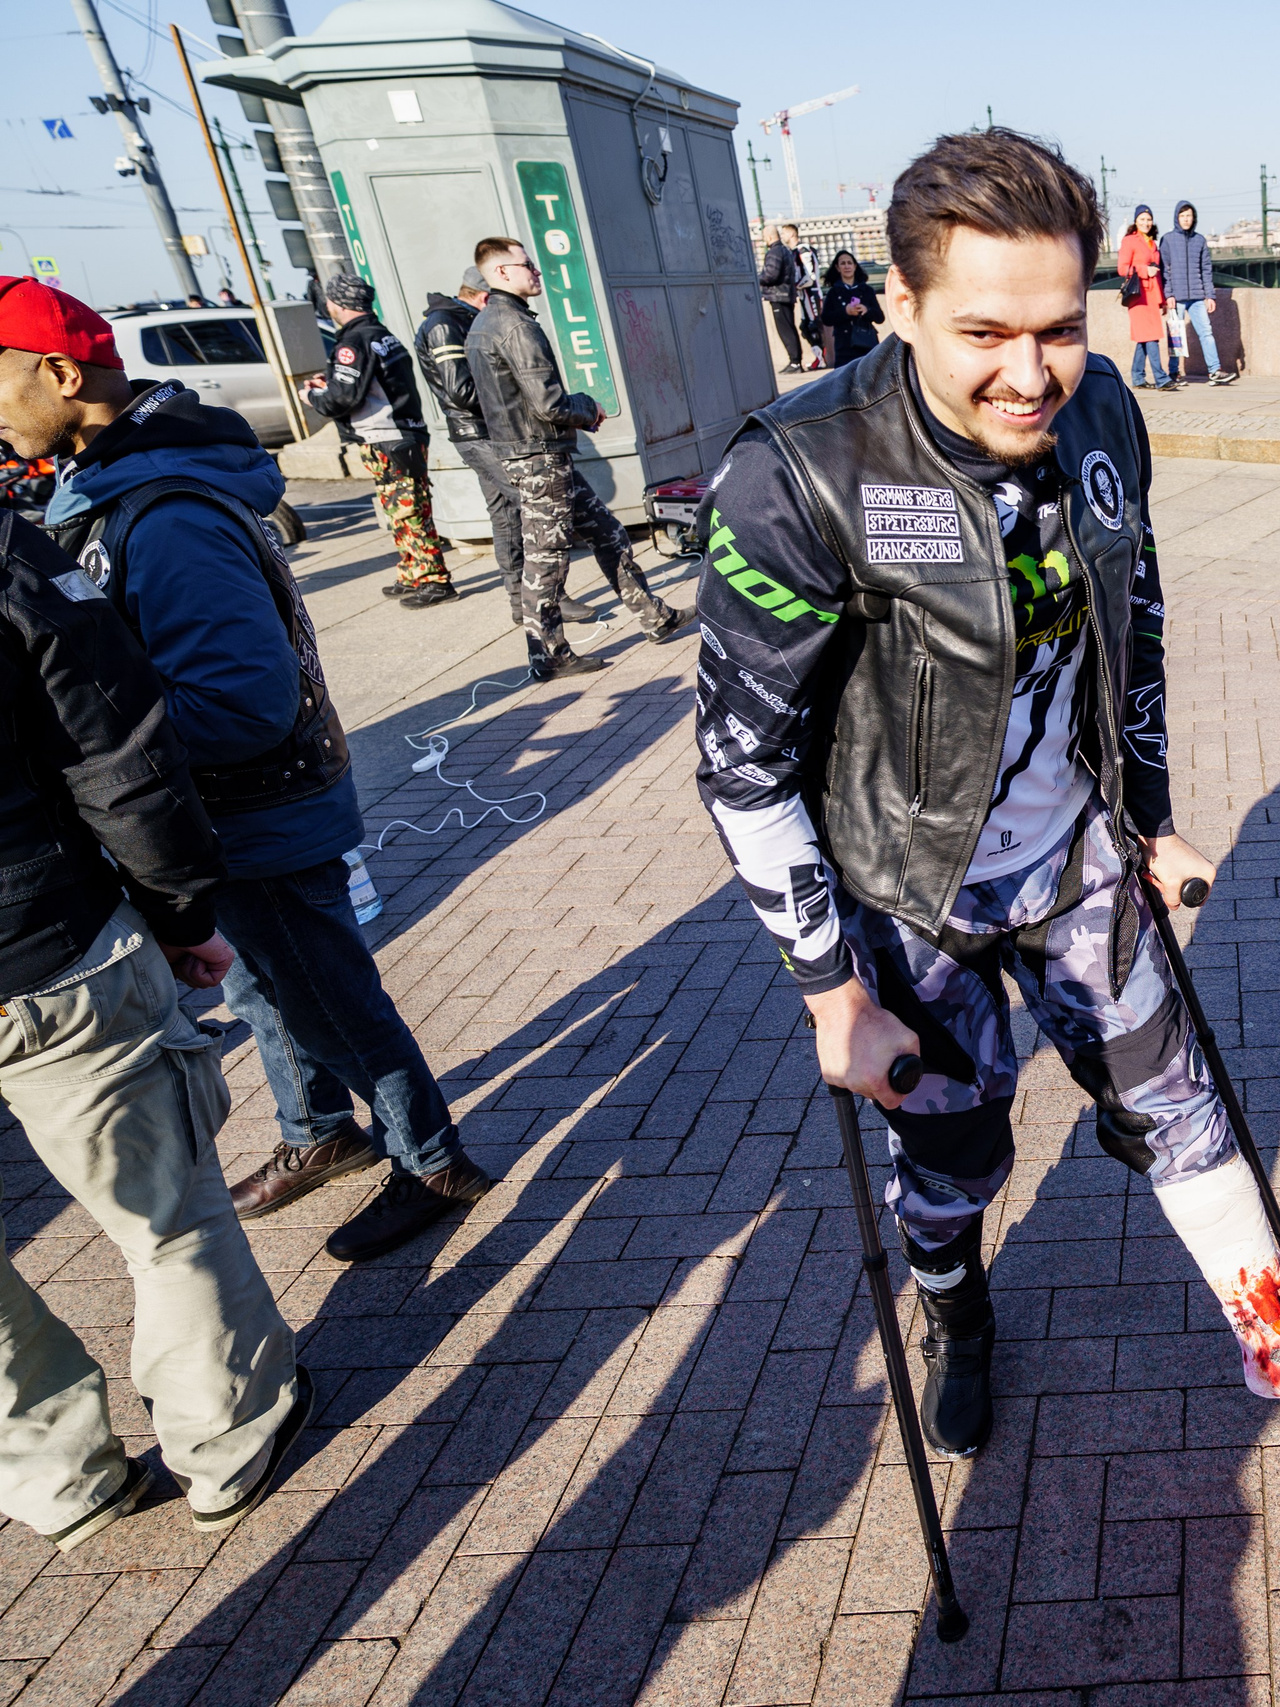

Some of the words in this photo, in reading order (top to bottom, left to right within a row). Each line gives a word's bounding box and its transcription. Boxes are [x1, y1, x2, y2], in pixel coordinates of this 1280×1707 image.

[534, 194, 598, 388] TOILET
[1083, 454, 1097, 482] SUPPORT
[865, 487, 914, 505] NORMANS
[914, 490, 952, 507] RIDERS
[871, 542, 960, 559] HANGAROUND
[728, 716, 756, 748] GET
